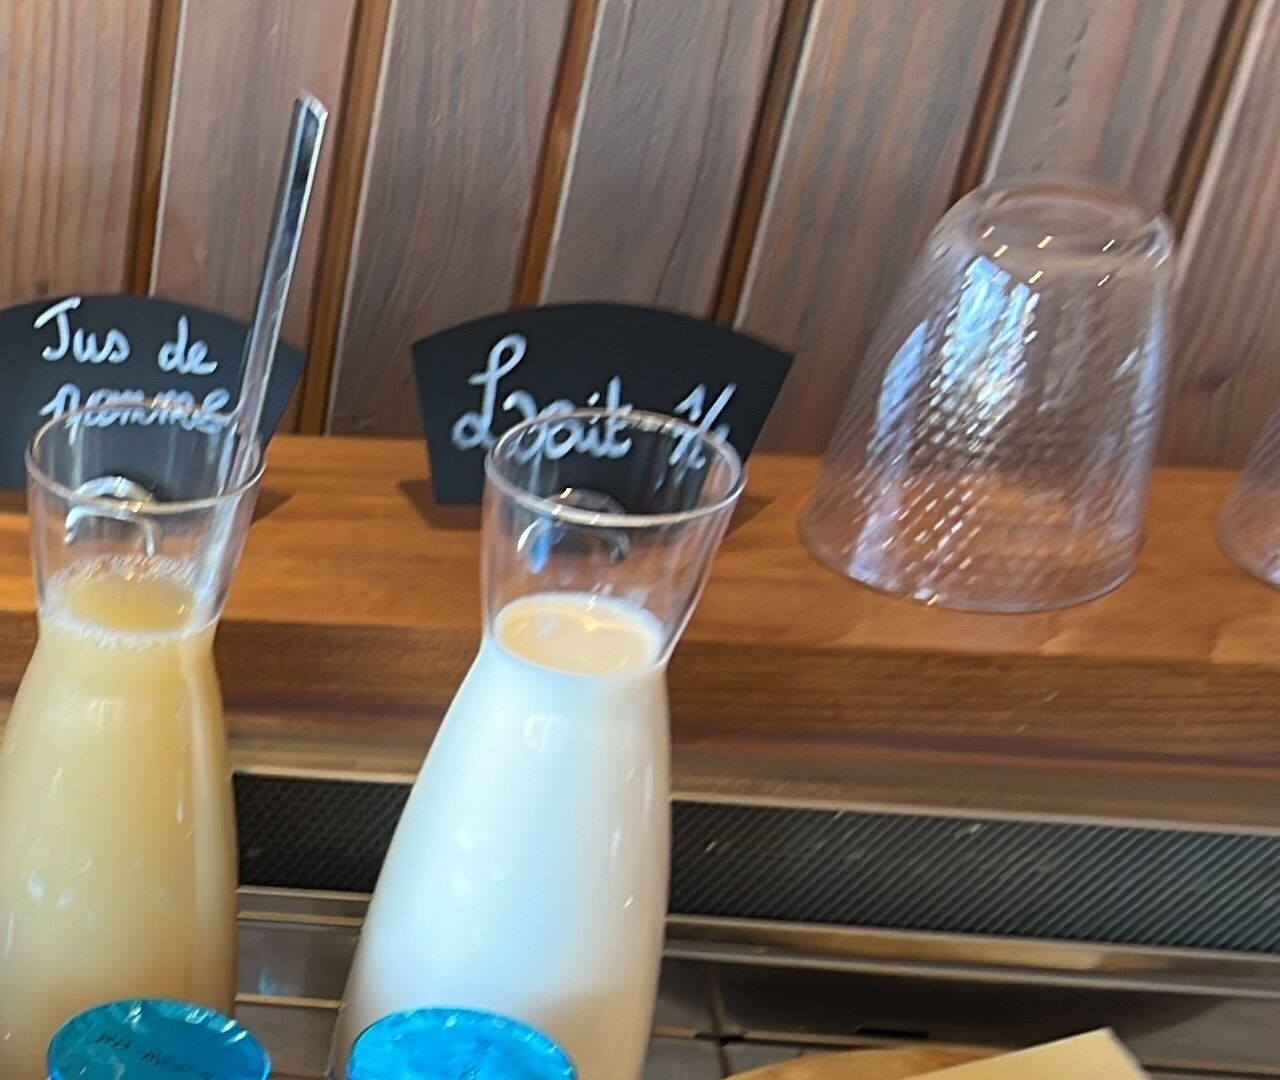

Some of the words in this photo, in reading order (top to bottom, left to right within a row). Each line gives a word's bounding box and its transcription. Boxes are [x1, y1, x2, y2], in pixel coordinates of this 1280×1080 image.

[33, 296, 131, 364] Jus
[157, 313, 218, 375] de
[39, 382, 231, 446] pomme
[451, 333, 633, 465] Lait
